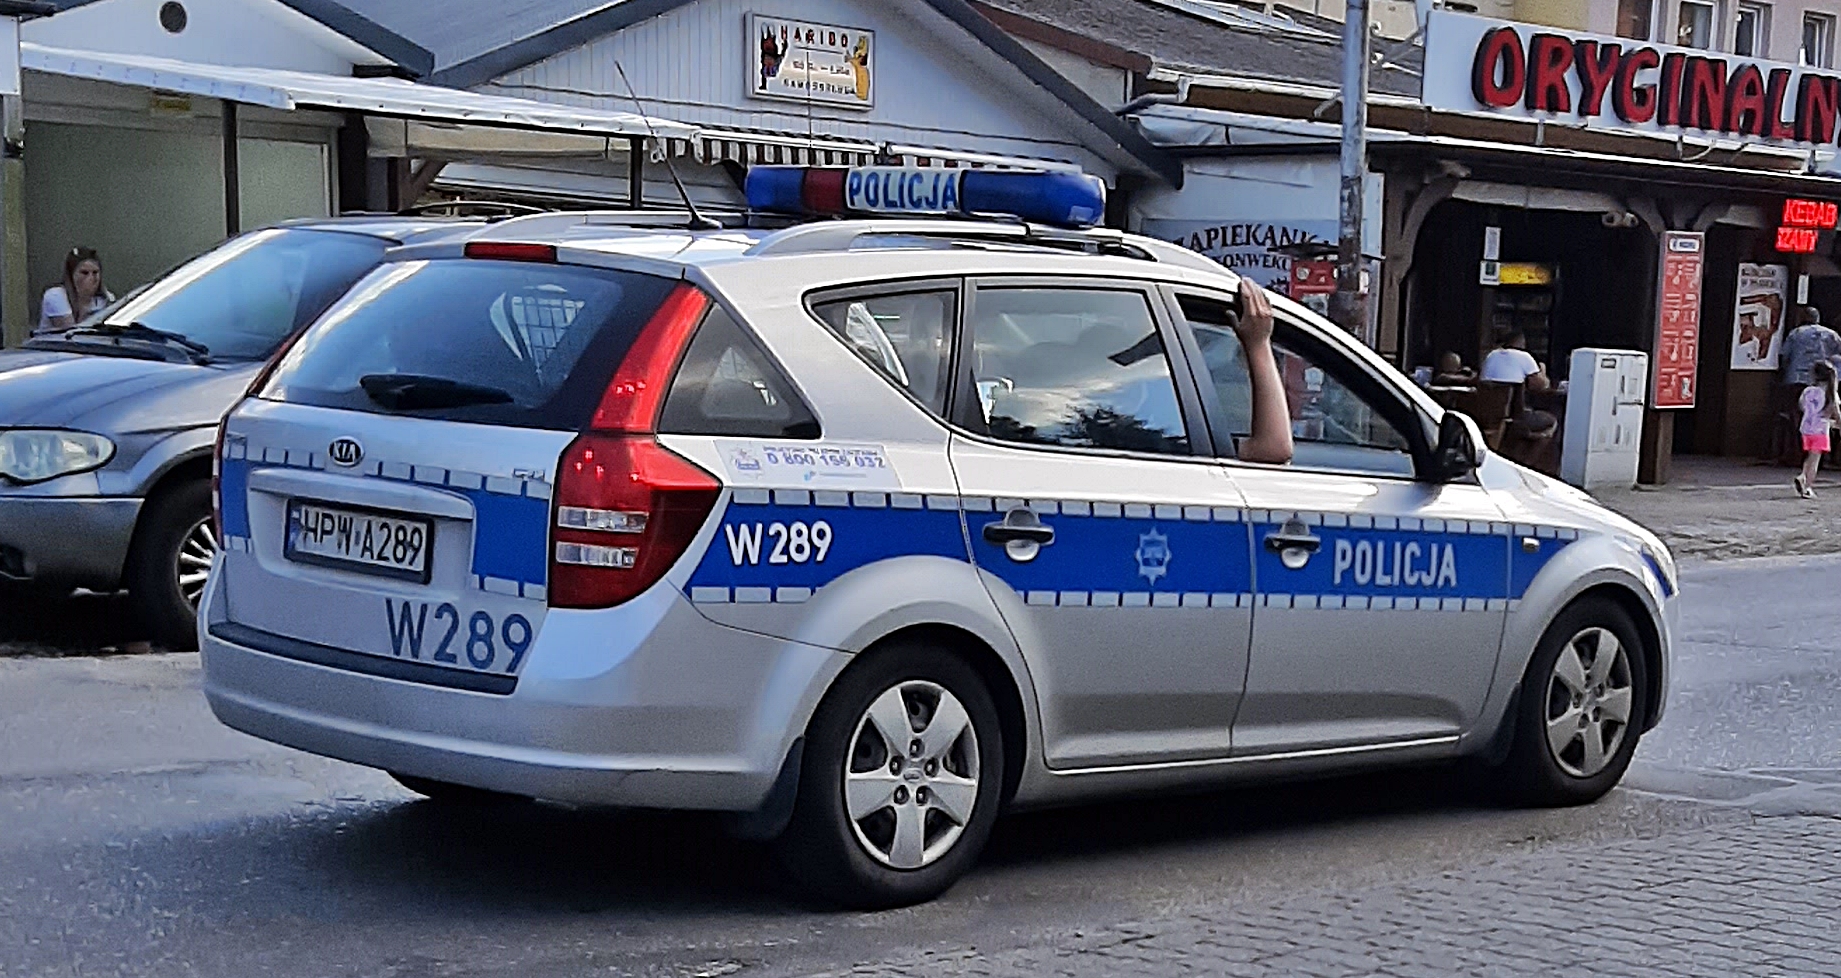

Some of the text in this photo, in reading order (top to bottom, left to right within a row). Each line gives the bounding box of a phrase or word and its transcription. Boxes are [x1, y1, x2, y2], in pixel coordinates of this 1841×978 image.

[1471, 26, 1841, 148] ORYGINALN
[848, 171, 958, 210] POLICJA
[1783, 198, 1838, 228] KEBAB
[331, 440, 359, 465] KIA
[302, 508, 423, 566] HPW A289
[1333, 538, 1458, 589] POLICJA
[385, 597, 533, 674] W289
